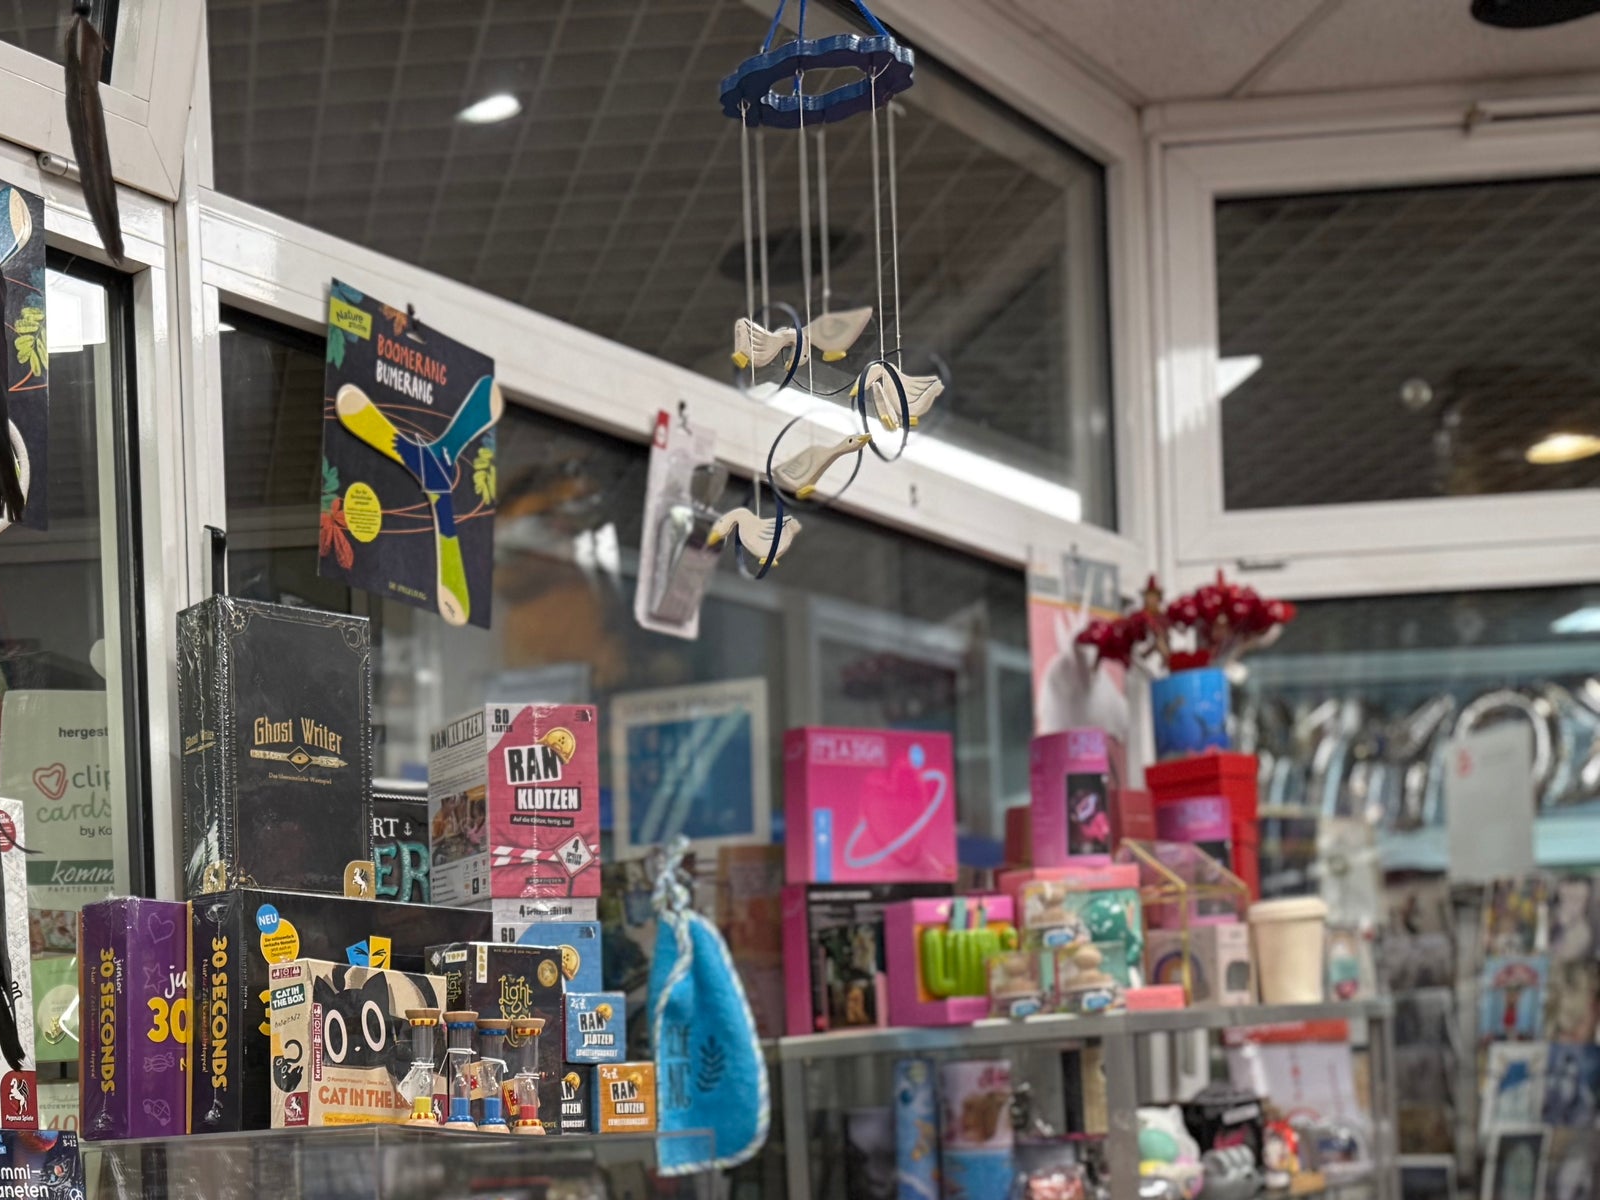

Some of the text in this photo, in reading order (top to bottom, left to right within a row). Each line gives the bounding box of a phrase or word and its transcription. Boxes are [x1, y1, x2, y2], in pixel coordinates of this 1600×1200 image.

[336, 307, 364, 324] Nature
[377, 334, 447, 385] BOOMERANG
[375, 360, 433, 405] BUMERANG
[253, 716, 342, 755] Ghost Writer
[505, 746, 560, 783] RAN
[517, 789, 580, 810] KLOTZEN
[258, 912, 278, 925] NEU
[211, 936, 229, 1089] 30 SECONDS
